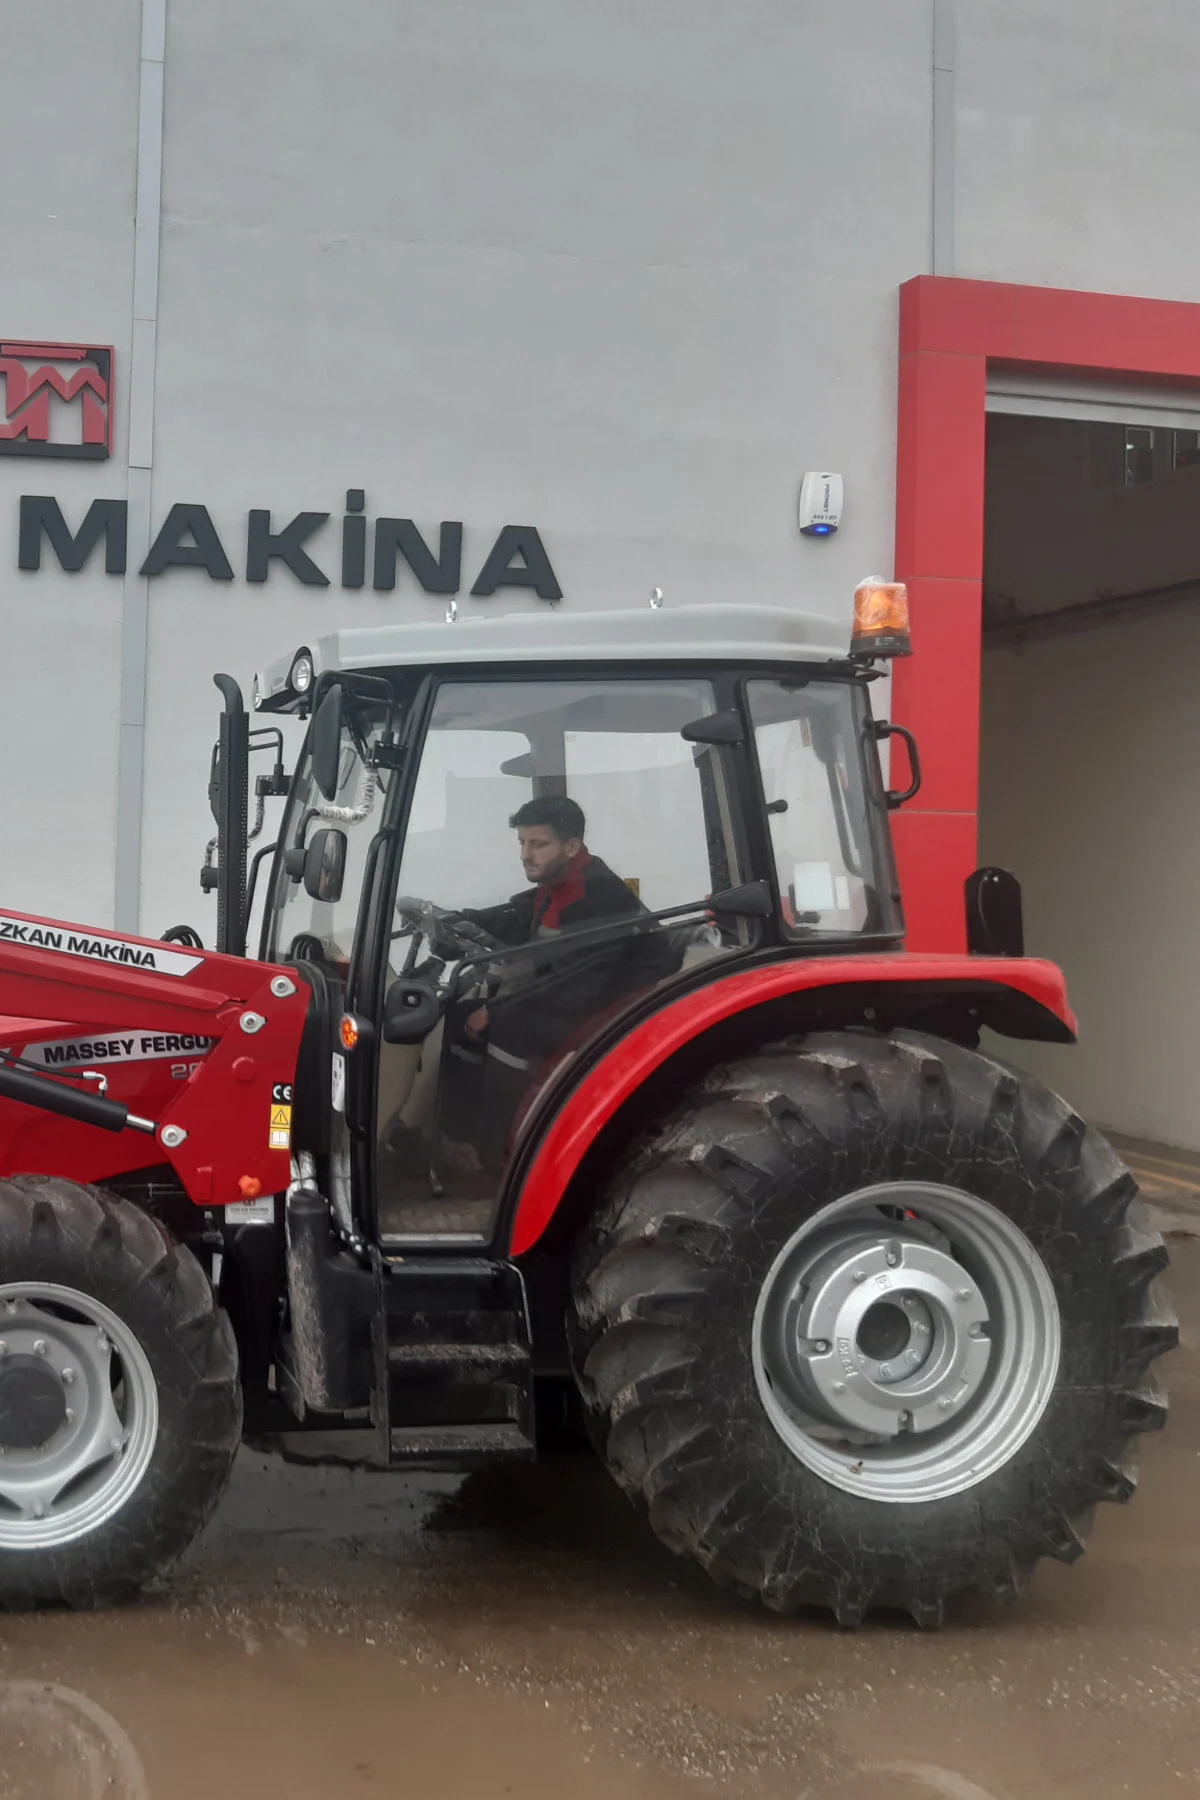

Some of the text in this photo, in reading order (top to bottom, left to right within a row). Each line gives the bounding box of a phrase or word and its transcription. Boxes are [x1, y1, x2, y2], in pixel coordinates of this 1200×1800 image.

[17, 488, 564, 600] MAKİNA
[66, 935, 157, 969] MAKİNA
[43, 1034, 212, 1064] MASSEY FERGU
[272, 1084, 292, 1100] CE
